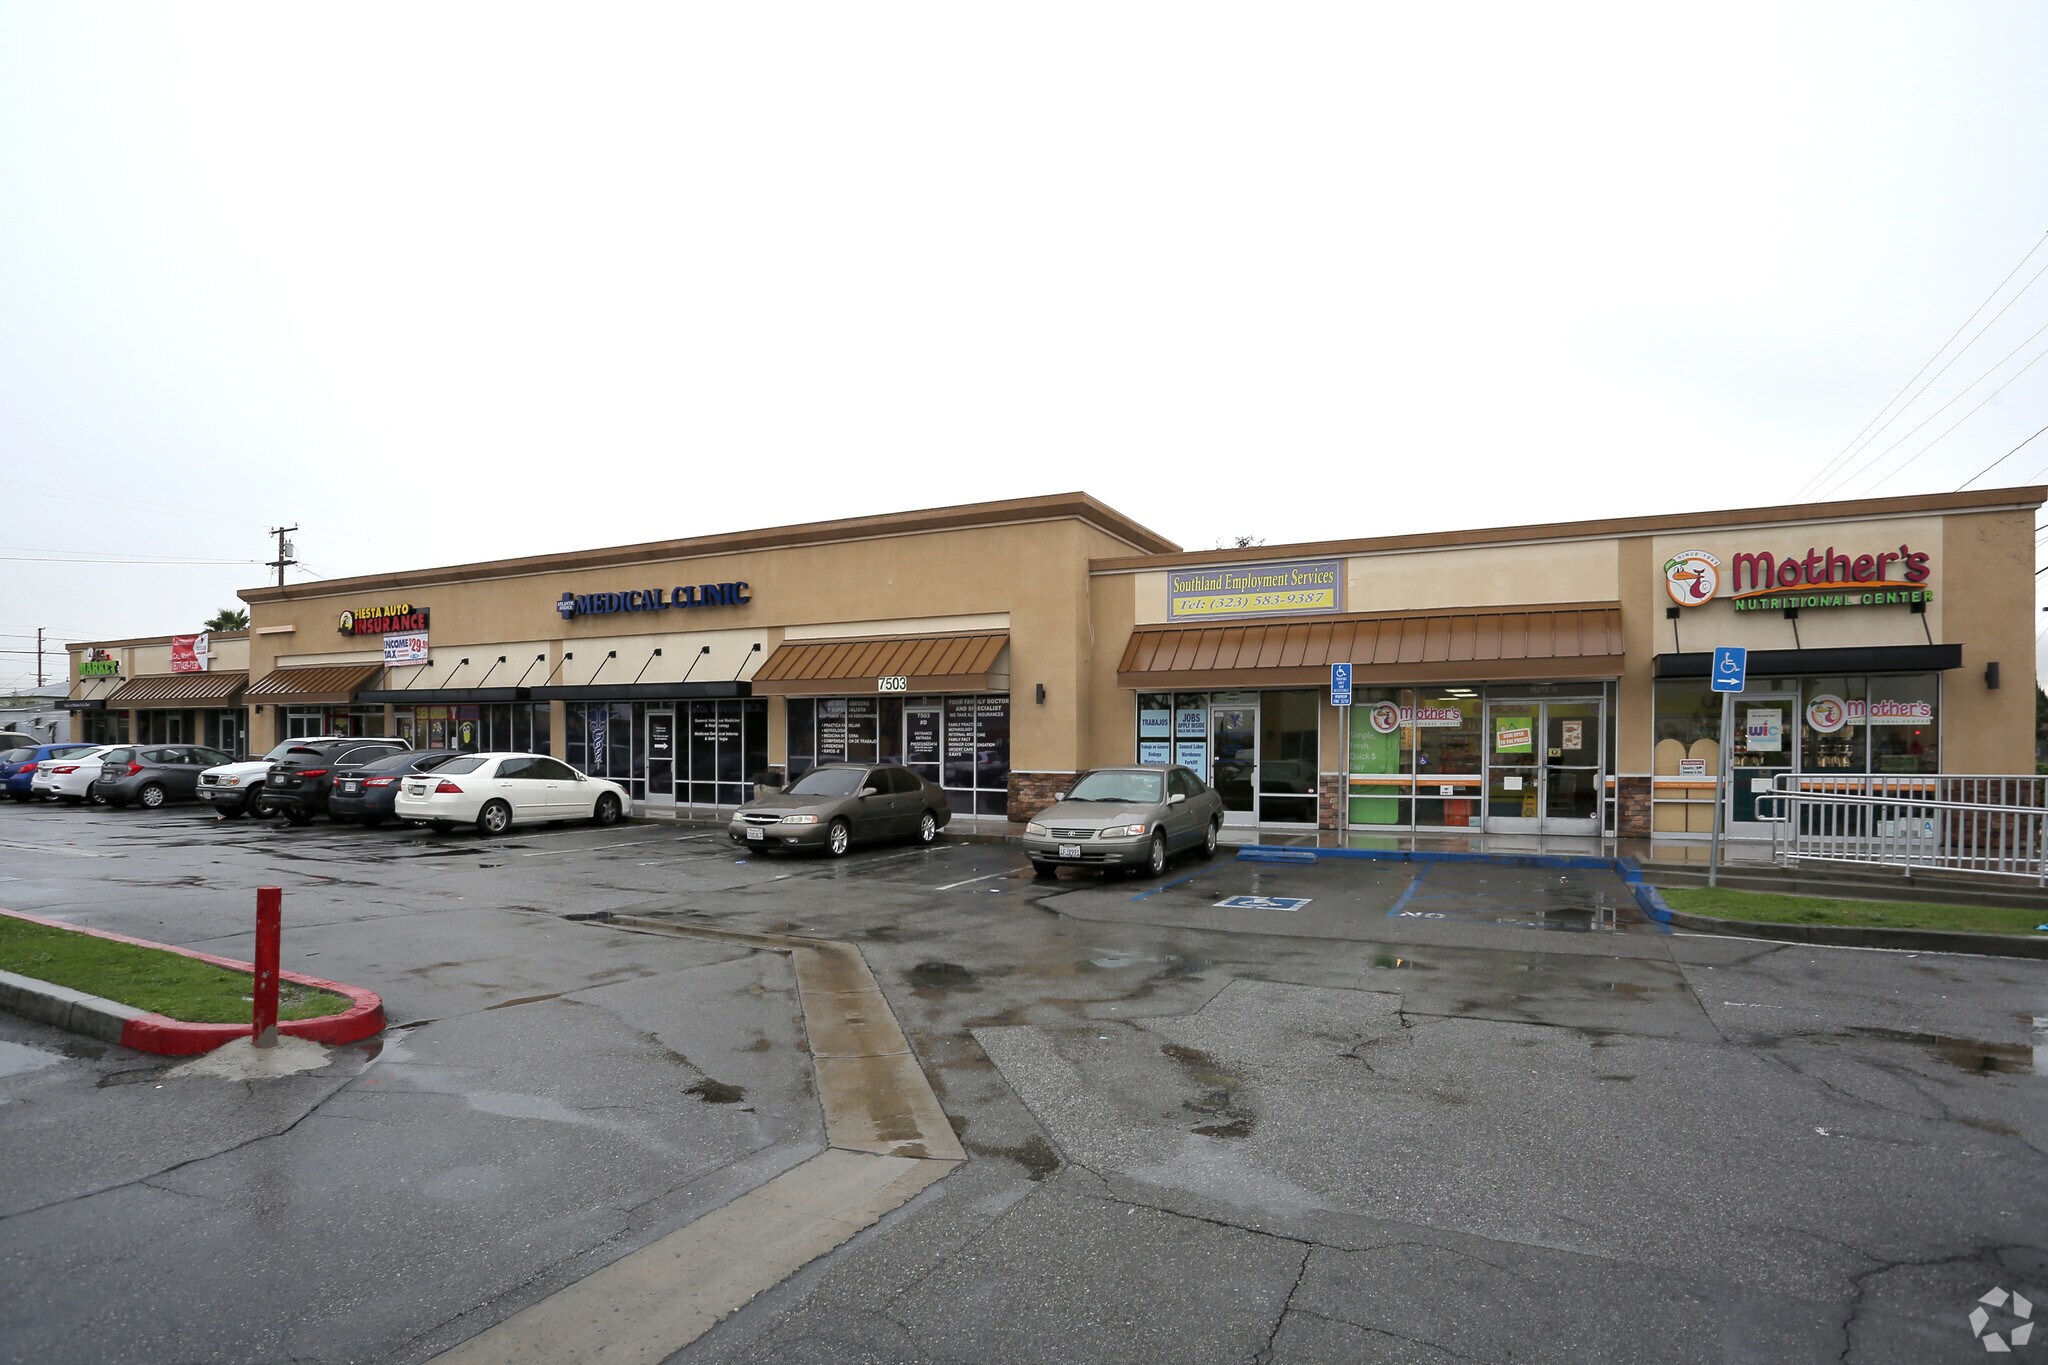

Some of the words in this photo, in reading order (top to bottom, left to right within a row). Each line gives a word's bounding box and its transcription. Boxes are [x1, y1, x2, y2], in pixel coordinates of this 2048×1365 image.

[1174, 574, 1222, 593] Southland
[1225, 572, 1288, 592] Employment
[1291, 568, 1334, 586] Services
[576, 588, 669, 616] MEDICAL
[671, 581, 752, 608] CLINIC
[1179, 599, 1206, 611] Tel:
[1209, 596, 1249, 610] (323)
[1253, 592, 1325, 607] 583-9387
[1735, 594, 1853, 611] NUTRITIONAL
[1862, 590, 1934, 606] CENTER
[354, 606, 382, 620] FIESTA
[384, 603, 410, 616] AUTO
[354, 614, 425, 635] INSURANCE
[384, 638, 408, 649] INCOME
[79, 660, 119, 676] MARKET
[878, 677, 906, 690] 7503
[1847, 700, 1930, 716] Mother's
[1142, 718, 1168, 726] TRABAJOS
[1182, 713, 1200, 722] JOBS
[1371, 752, 1376, 760] &
[1400, 910, 1446, 919] NO
